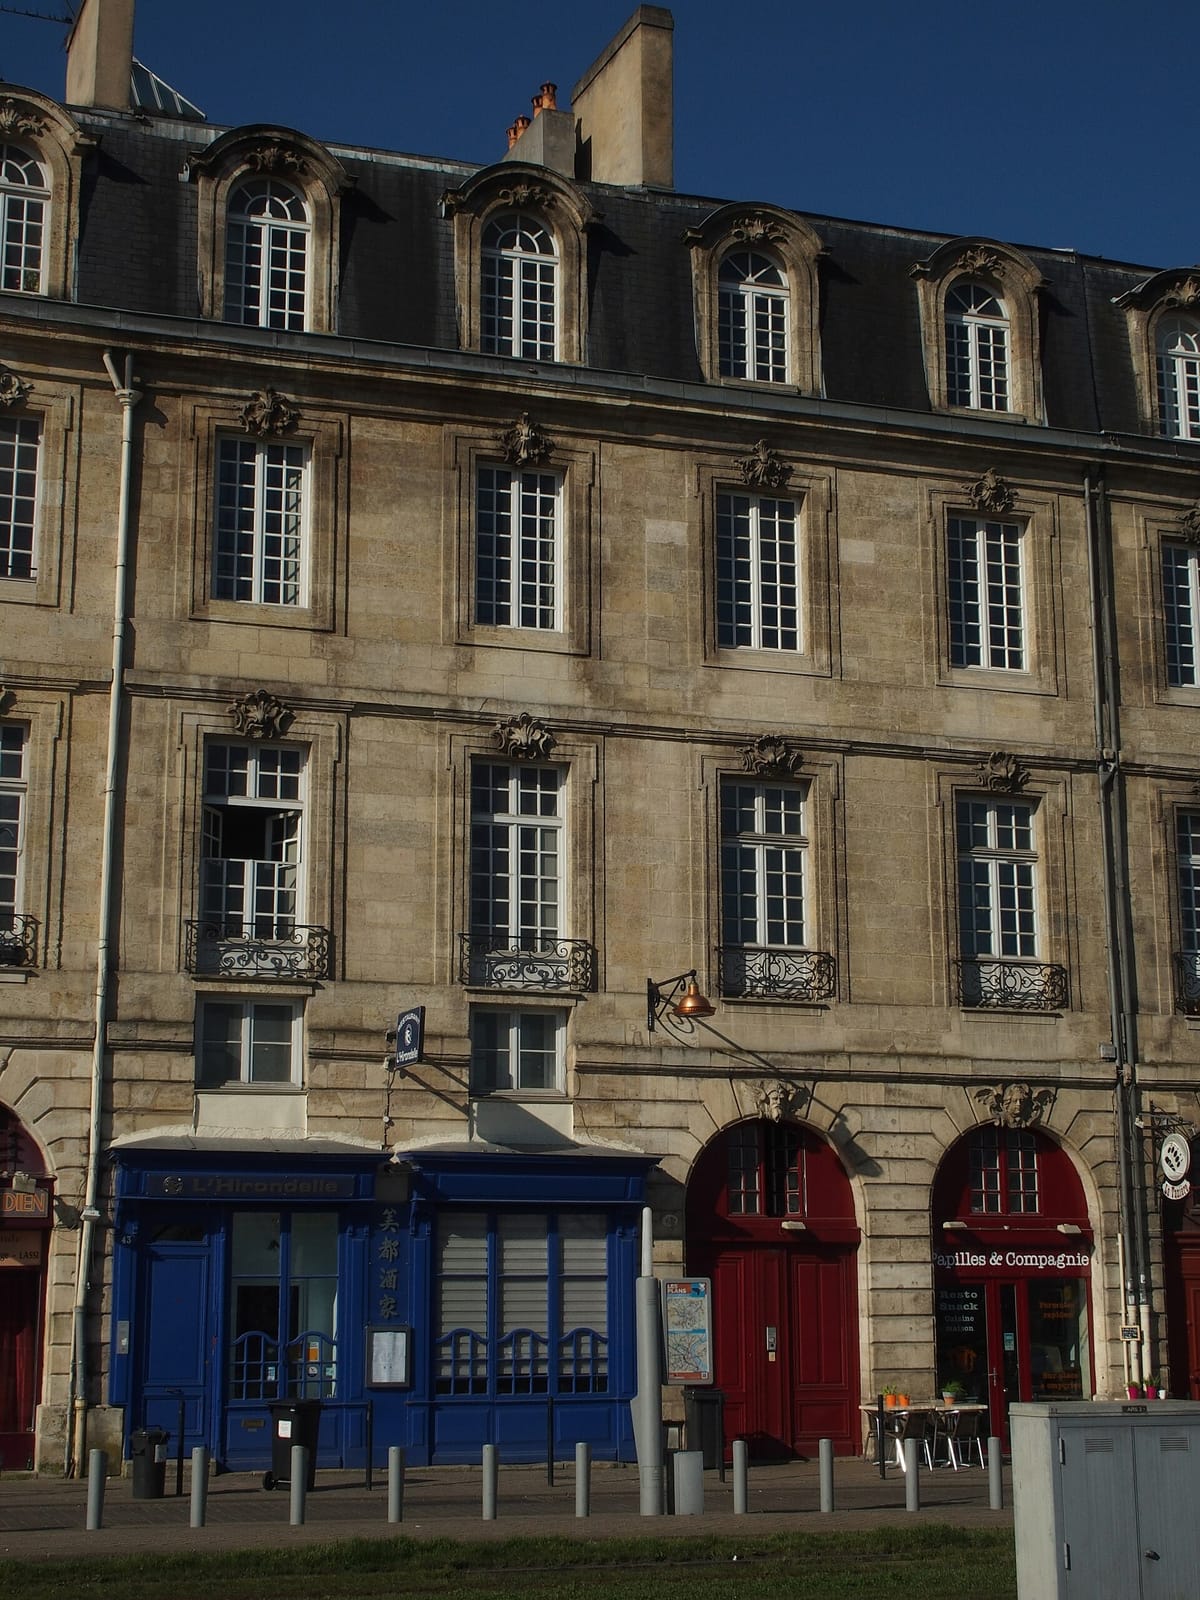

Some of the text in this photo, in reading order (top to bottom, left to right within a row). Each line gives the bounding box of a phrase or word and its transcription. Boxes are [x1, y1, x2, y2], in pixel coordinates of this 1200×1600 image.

[192, 1177, 338, 1193] L'Hirondelle
[989, 1252, 1003, 1266] &
[1005, 1252, 1090, 1269] Compagnie
